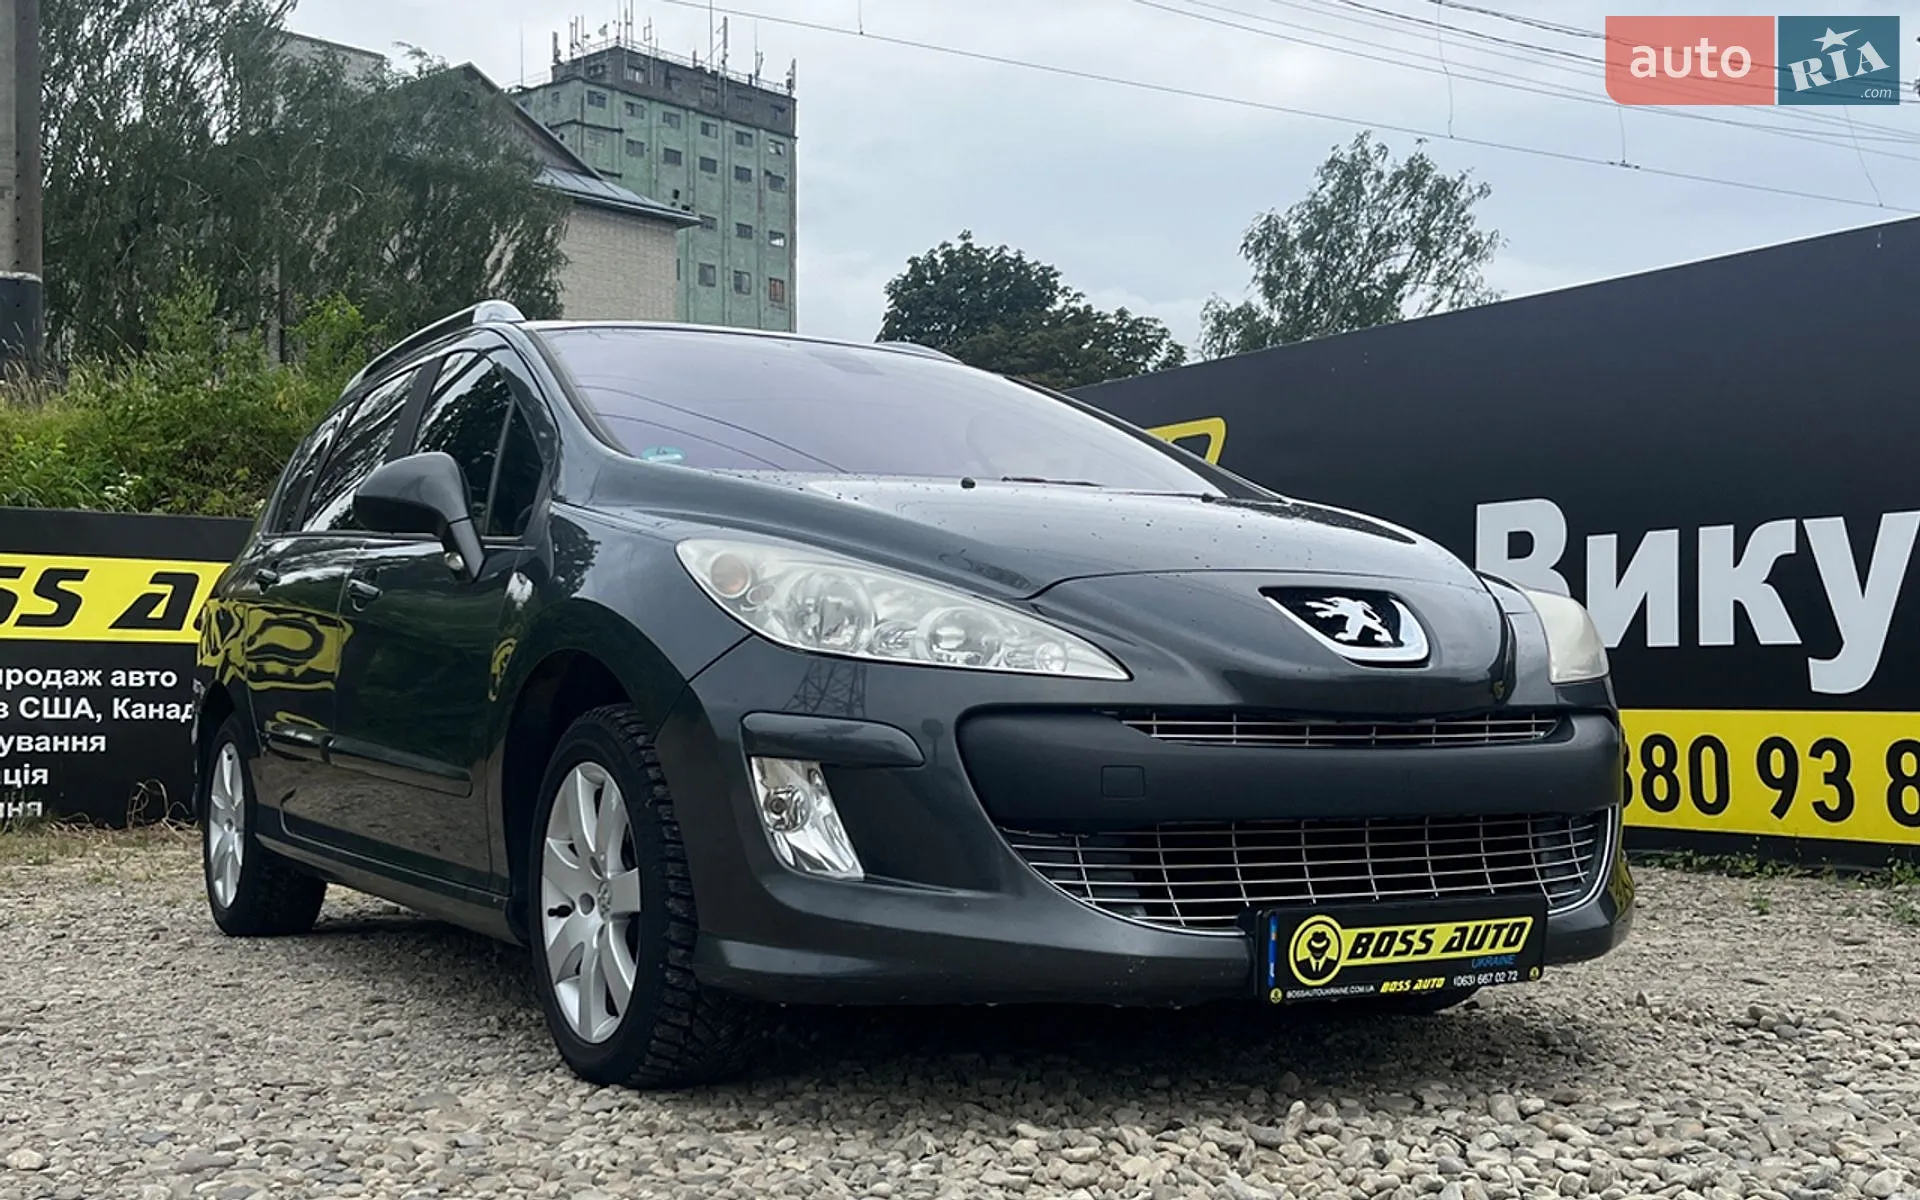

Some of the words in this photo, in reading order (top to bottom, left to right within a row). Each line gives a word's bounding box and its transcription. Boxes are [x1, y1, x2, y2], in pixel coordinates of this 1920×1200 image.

[0, 668, 102, 691] родаж
[110, 669, 178, 688] авто
[19, 697, 102, 723] США,
[0, 763, 49, 788] ція
[1622, 733, 1731, 816] 80
[1756, 736, 1855, 824] 93
[1885, 739, 1920, 827] 8
[1347, 928, 1435, 960] BOSS
[1440, 920, 1528, 954] AUTO
[1380, 980, 1412, 993] BOSS
[1413, 977, 1446, 990] AUTO
